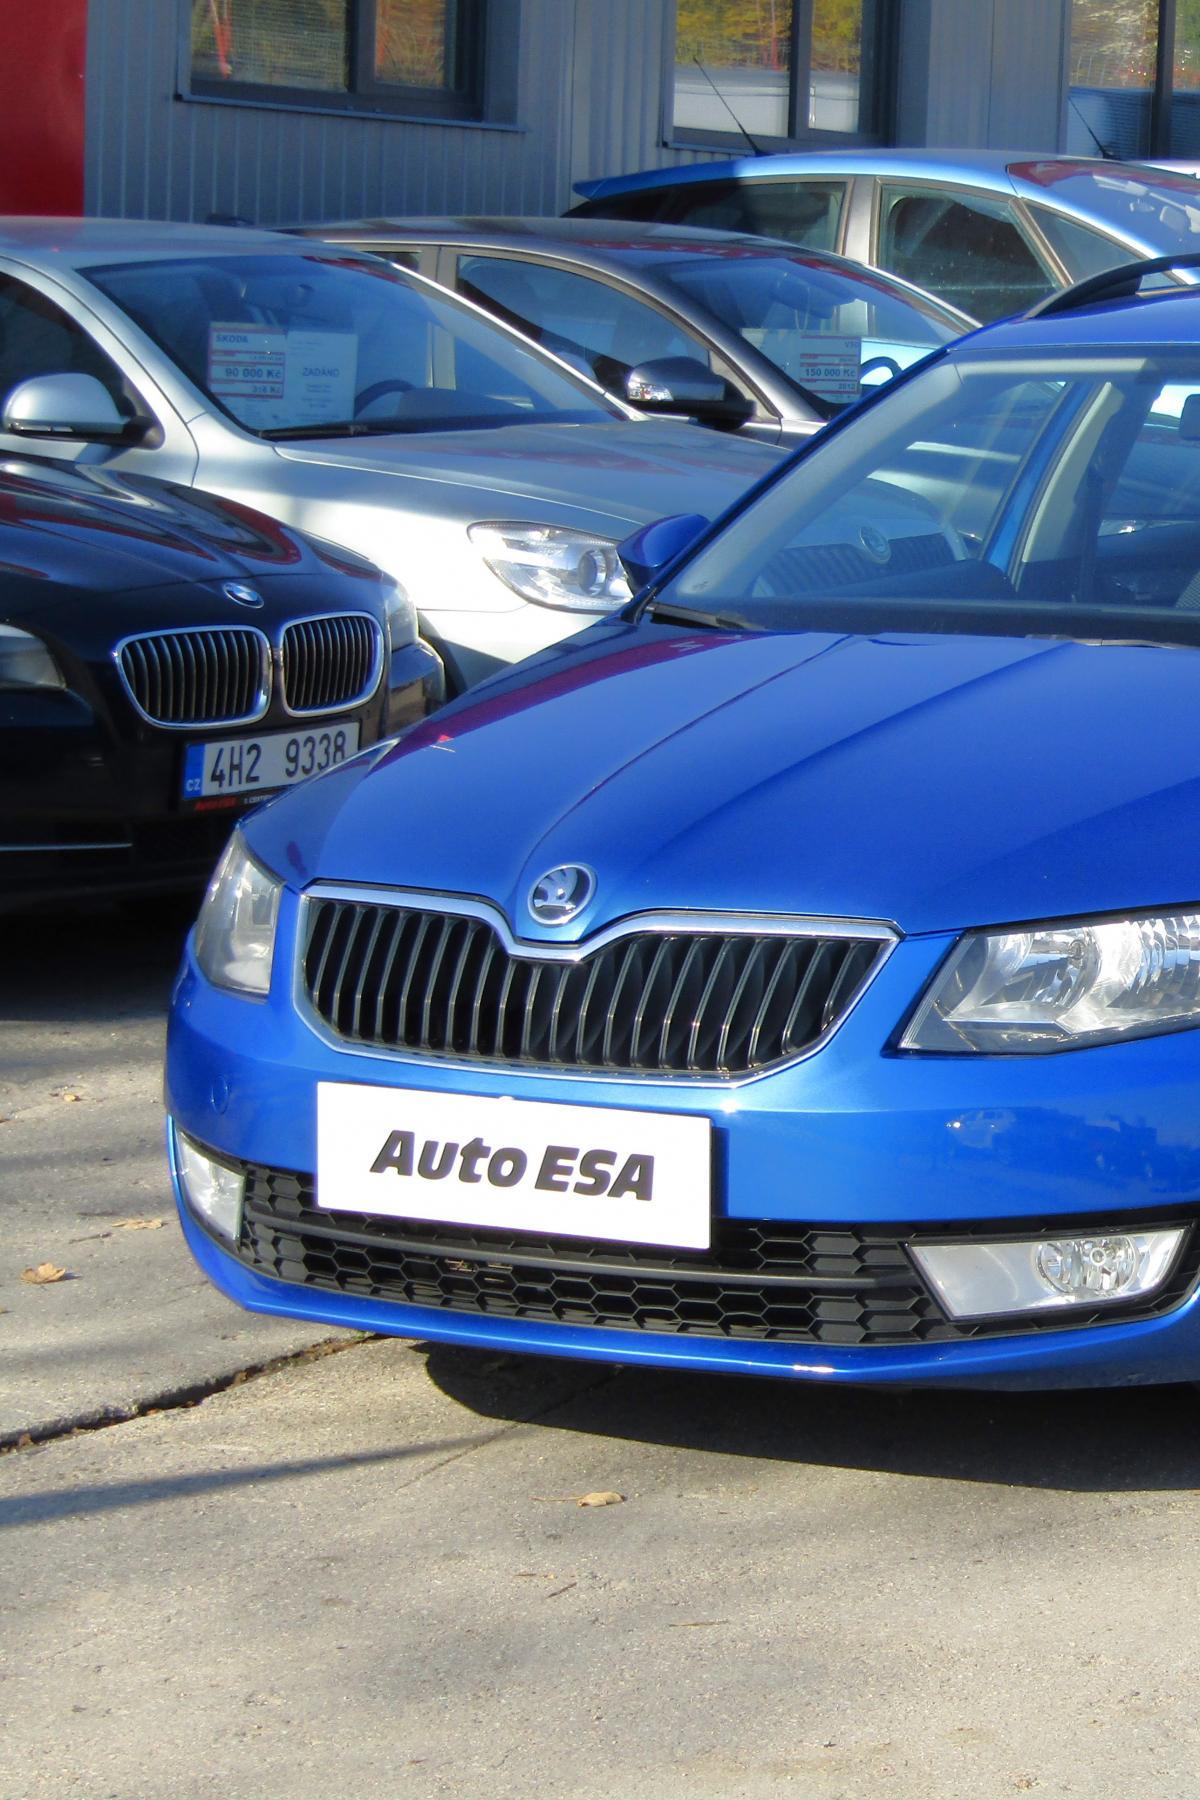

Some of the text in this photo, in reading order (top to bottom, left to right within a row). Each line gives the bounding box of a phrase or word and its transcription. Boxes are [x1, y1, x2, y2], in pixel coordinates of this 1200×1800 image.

[185, 779, 201, 792] CZ
[211, 730, 347, 788] 4H2 9338
[370, 1129, 655, 1201] Auto ESA
